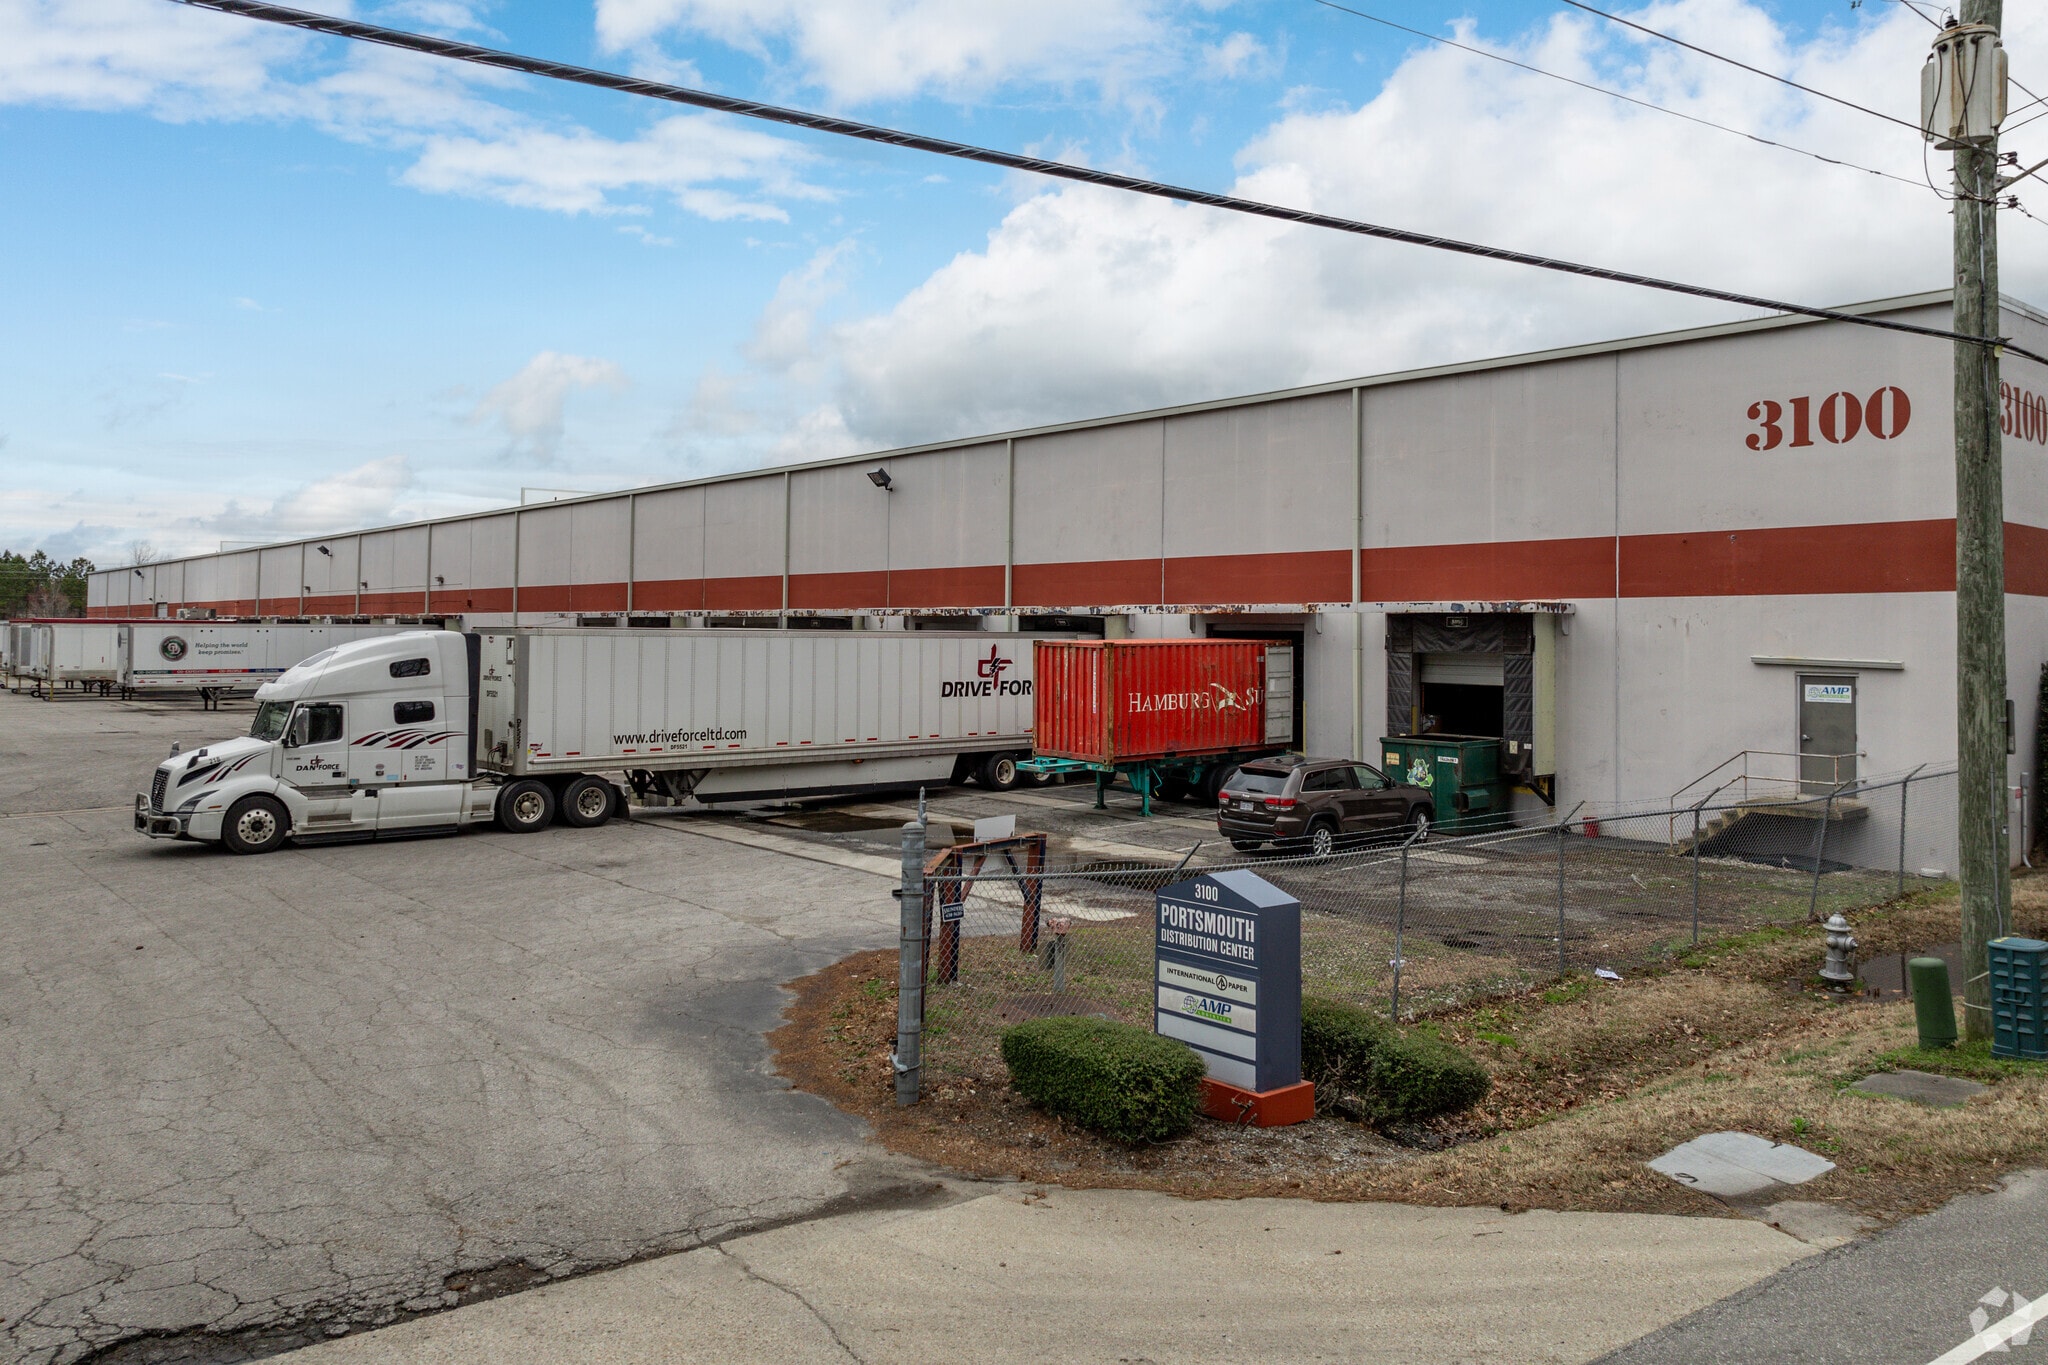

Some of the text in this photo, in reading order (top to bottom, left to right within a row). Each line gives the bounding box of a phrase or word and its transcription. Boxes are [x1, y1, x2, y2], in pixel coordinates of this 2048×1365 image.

[1745, 386, 1912, 451] 3100
[2000, 381, 2048, 446] 3100
[941, 680, 1033, 698] DRIVE FOR
[1128, 686, 1265, 712] HAMBURG SÜ
[1821, 686, 1850, 695] AMP
[613, 727, 747, 744] www.driveforceltd.com
[1194, 883, 1218, 901] 3100
[1161, 903, 1255, 943] PORTSMOUTH
[1161, 928, 1255, 961] DISTRIBUTION CENTER
[1166, 967, 1248, 993] INTERNATIONAL PAPER
[1198, 998, 1232, 1015] AMP
